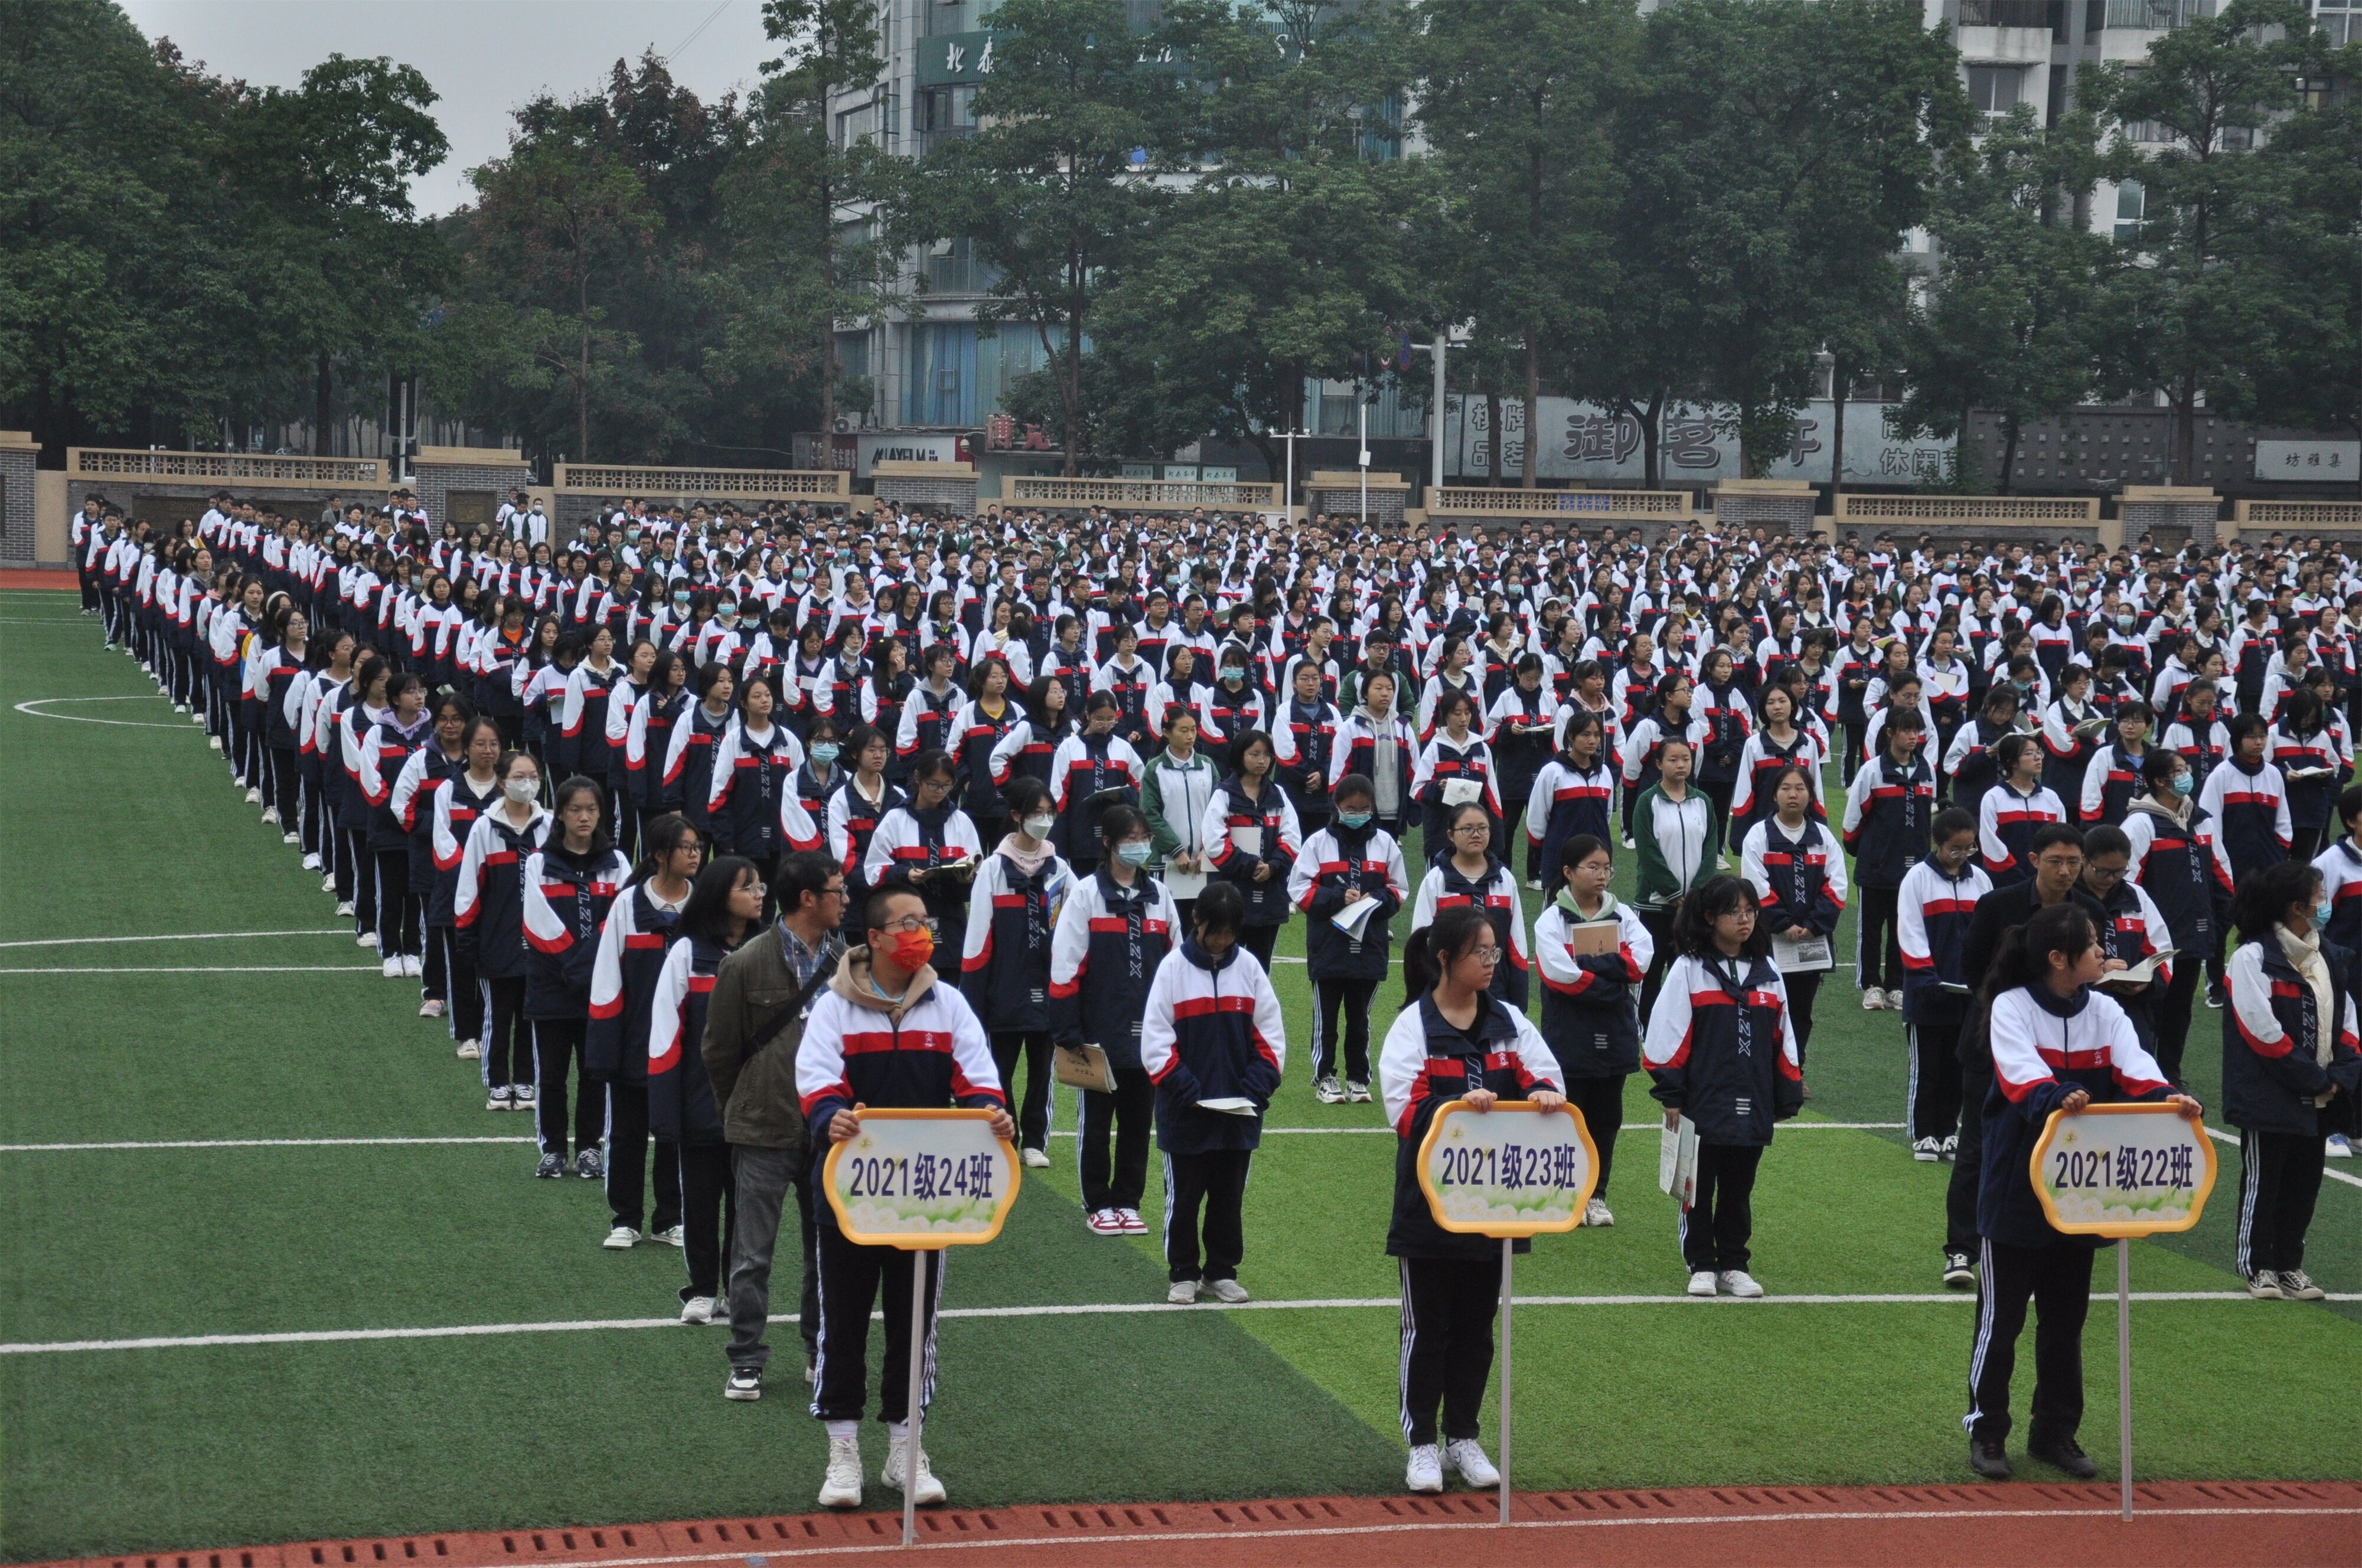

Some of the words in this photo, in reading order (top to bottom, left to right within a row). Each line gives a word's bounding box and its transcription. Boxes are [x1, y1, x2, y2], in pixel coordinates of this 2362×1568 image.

[1027, 889, 1039, 949] SLZX
[1128, 912, 1142, 979] SLZX
[850, 1152, 993, 1201] 2021级24班
[1442, 1142, 1575, 1190] 2021级23班
[2056, 1144, 2193, 1191] 2021级22班
